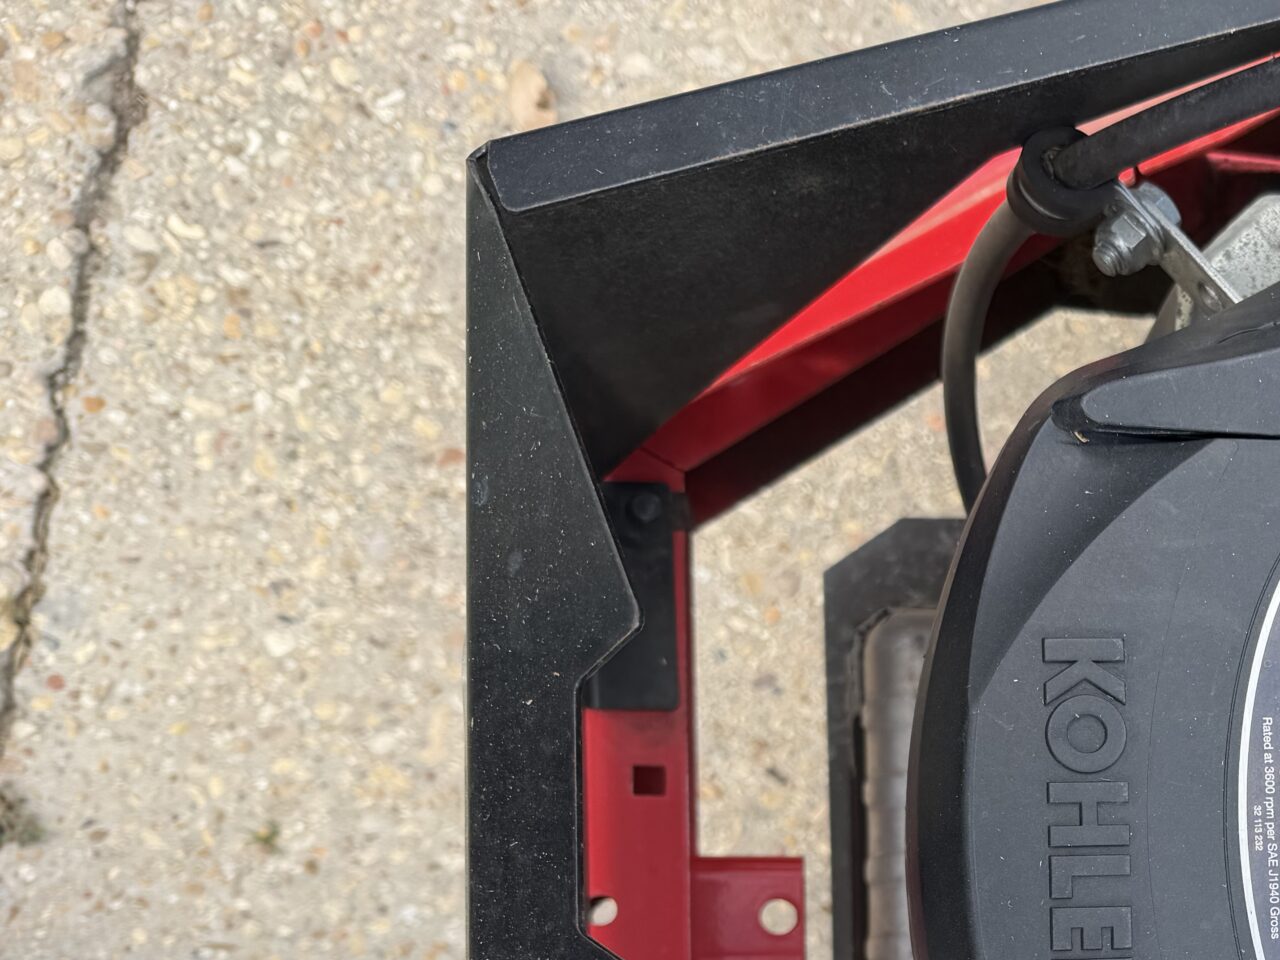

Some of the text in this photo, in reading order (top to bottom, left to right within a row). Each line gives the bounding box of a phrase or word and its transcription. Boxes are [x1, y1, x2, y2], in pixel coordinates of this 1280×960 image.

[1253, 804, 1264, 851] 32 113 232
[1262, 716, 1280, 940] Rated at 3600 rpm per SAE J1940 Gross
